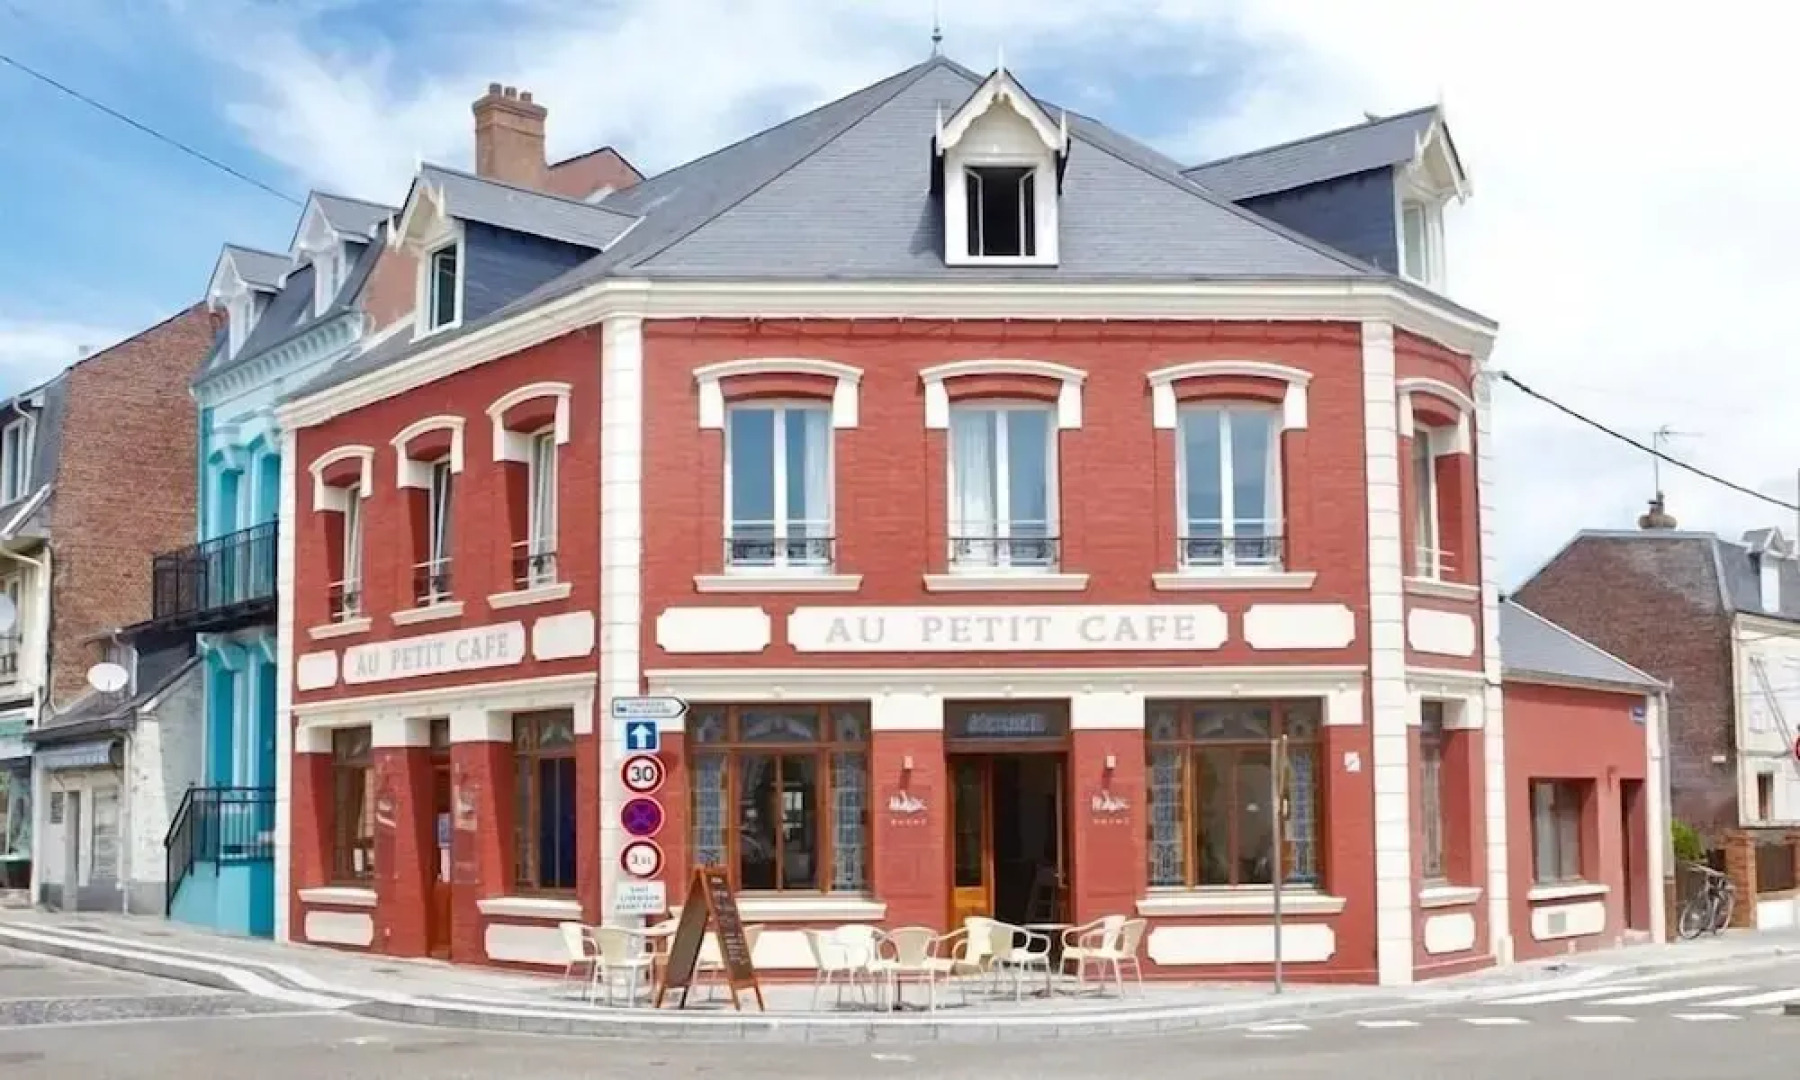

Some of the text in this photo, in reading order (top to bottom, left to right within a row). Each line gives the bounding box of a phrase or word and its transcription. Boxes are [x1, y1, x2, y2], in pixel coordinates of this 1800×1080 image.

[825, 614, 1198, 644] AU PETIT CAFE
[355, 632, 510, 677] AU PETIT CAFE
[631, 766, 654, 782] 30
